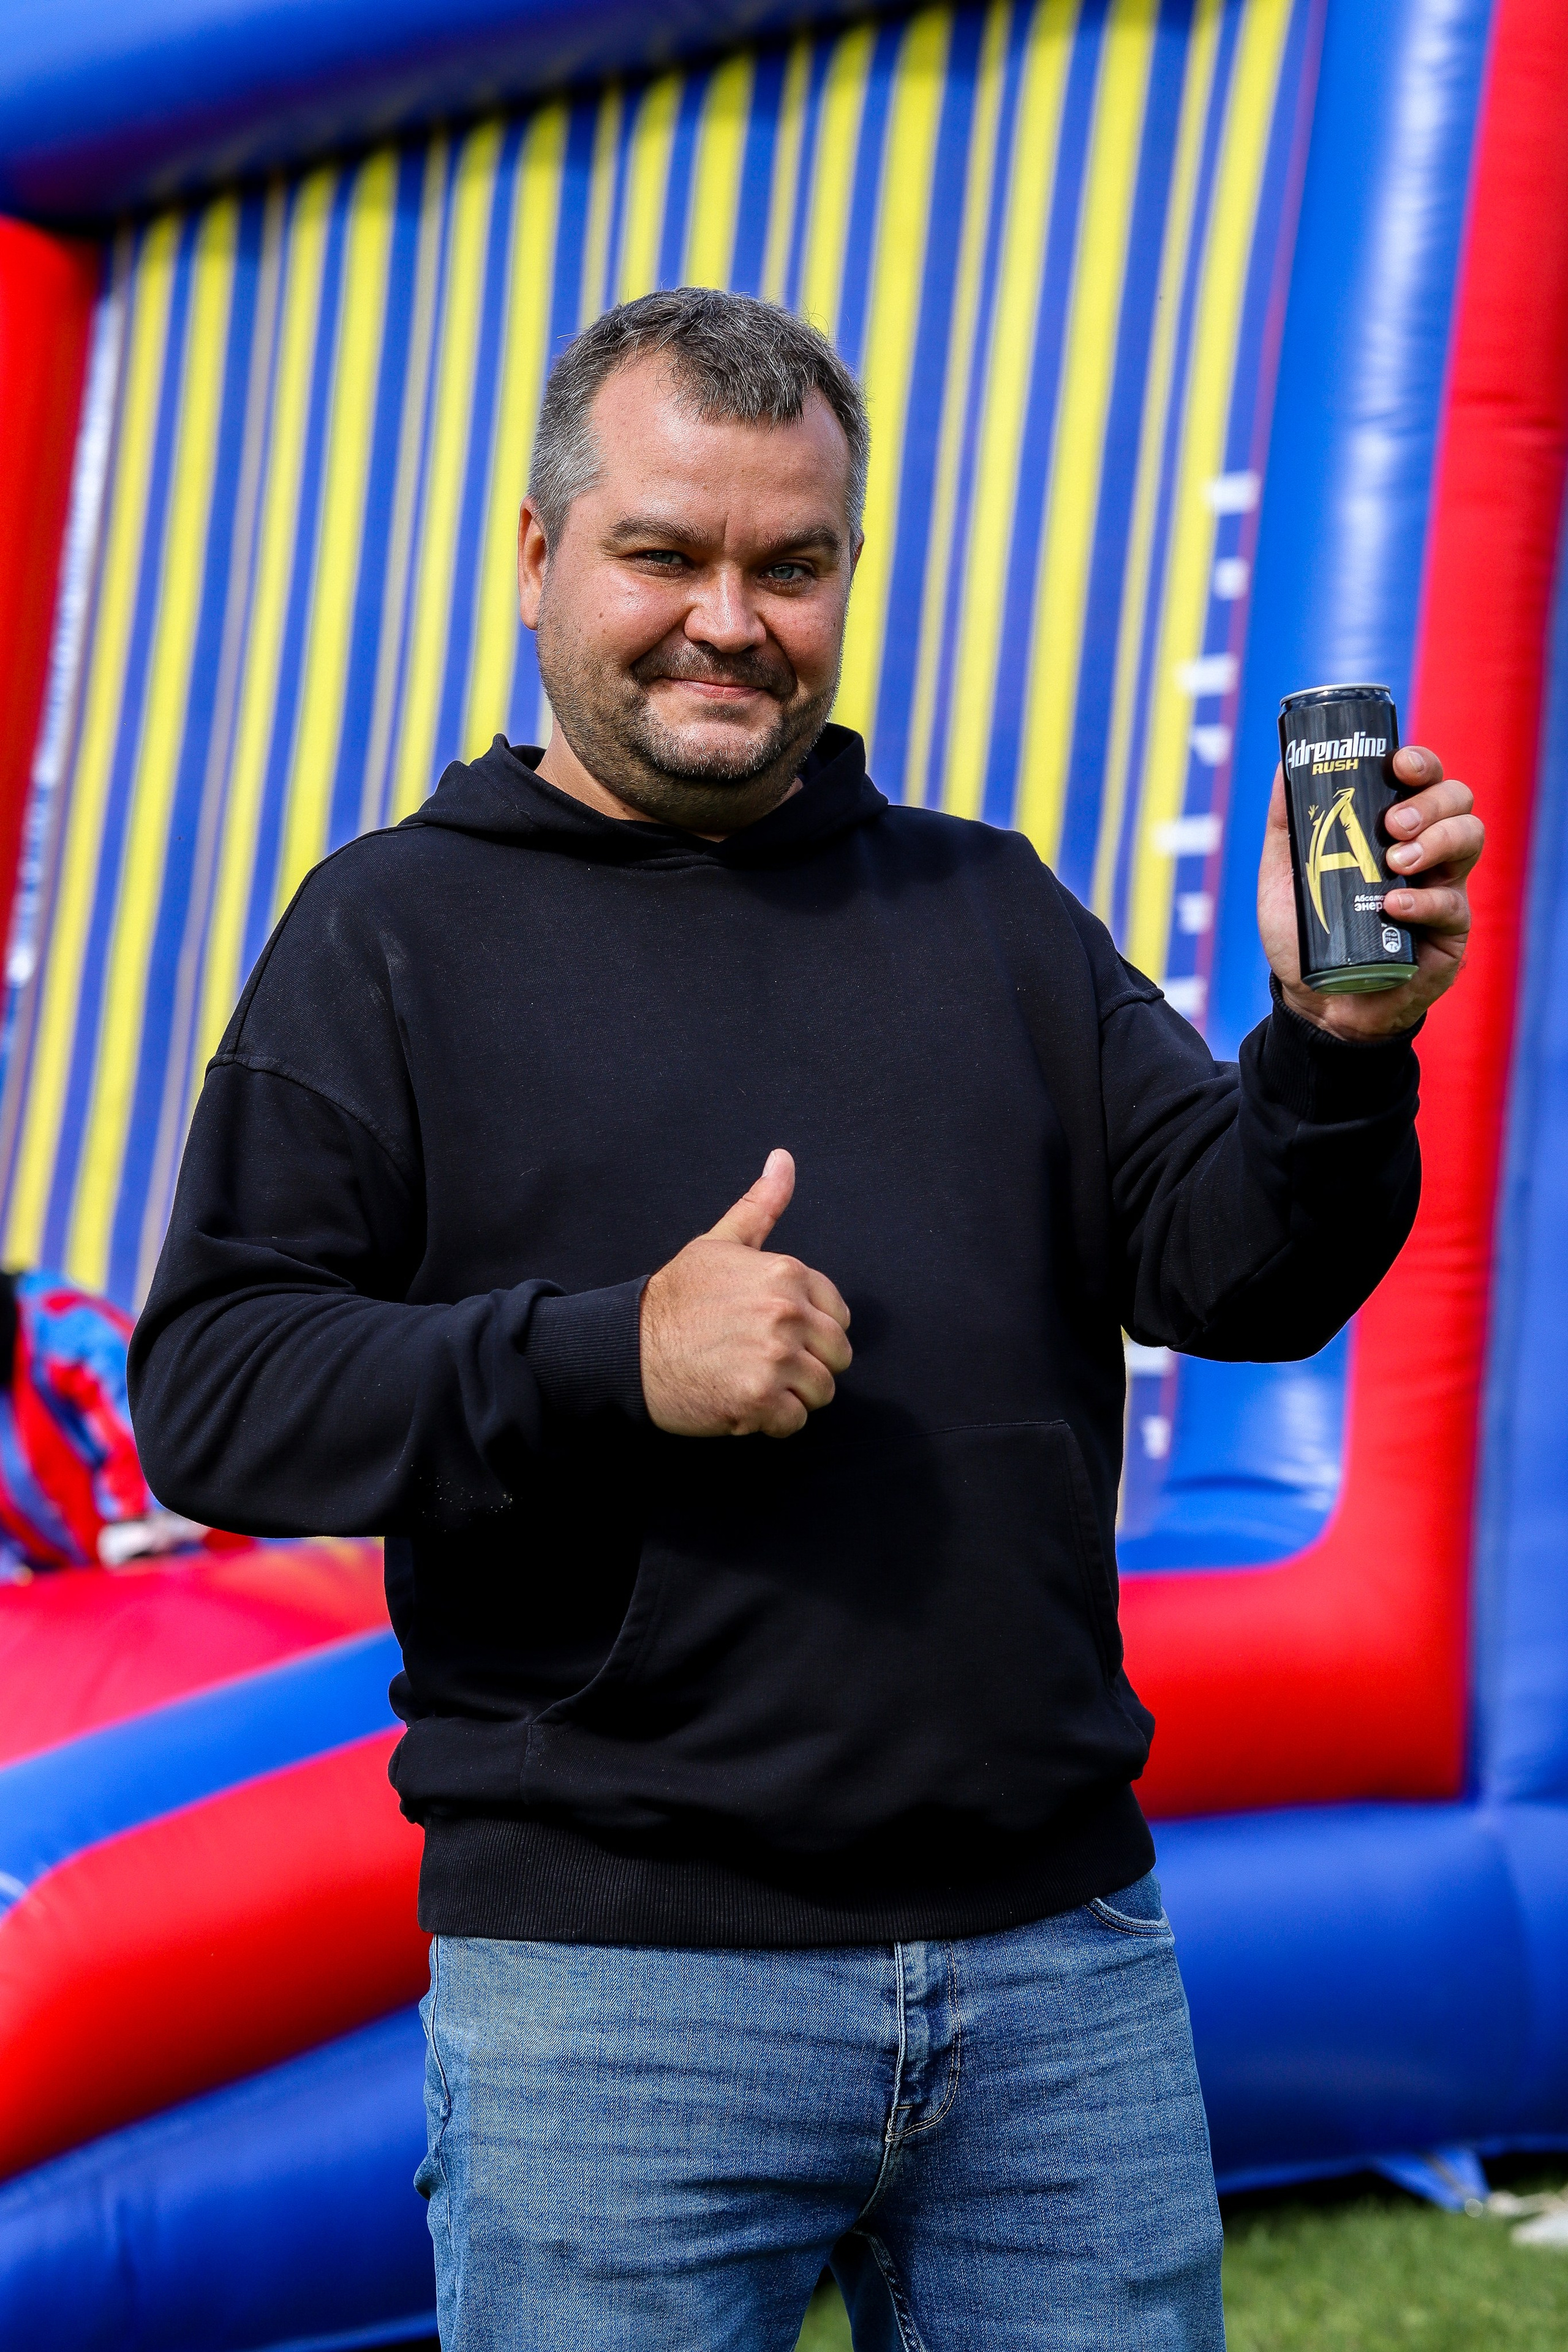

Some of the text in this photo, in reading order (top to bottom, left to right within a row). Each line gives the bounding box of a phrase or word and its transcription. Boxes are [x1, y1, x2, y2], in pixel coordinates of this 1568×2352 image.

[1286, 731, 1387, 774] Adrenaline
[1312, 758, 1359, 775] RUSH
[1354, 894, 1385, 903] Абсолю
